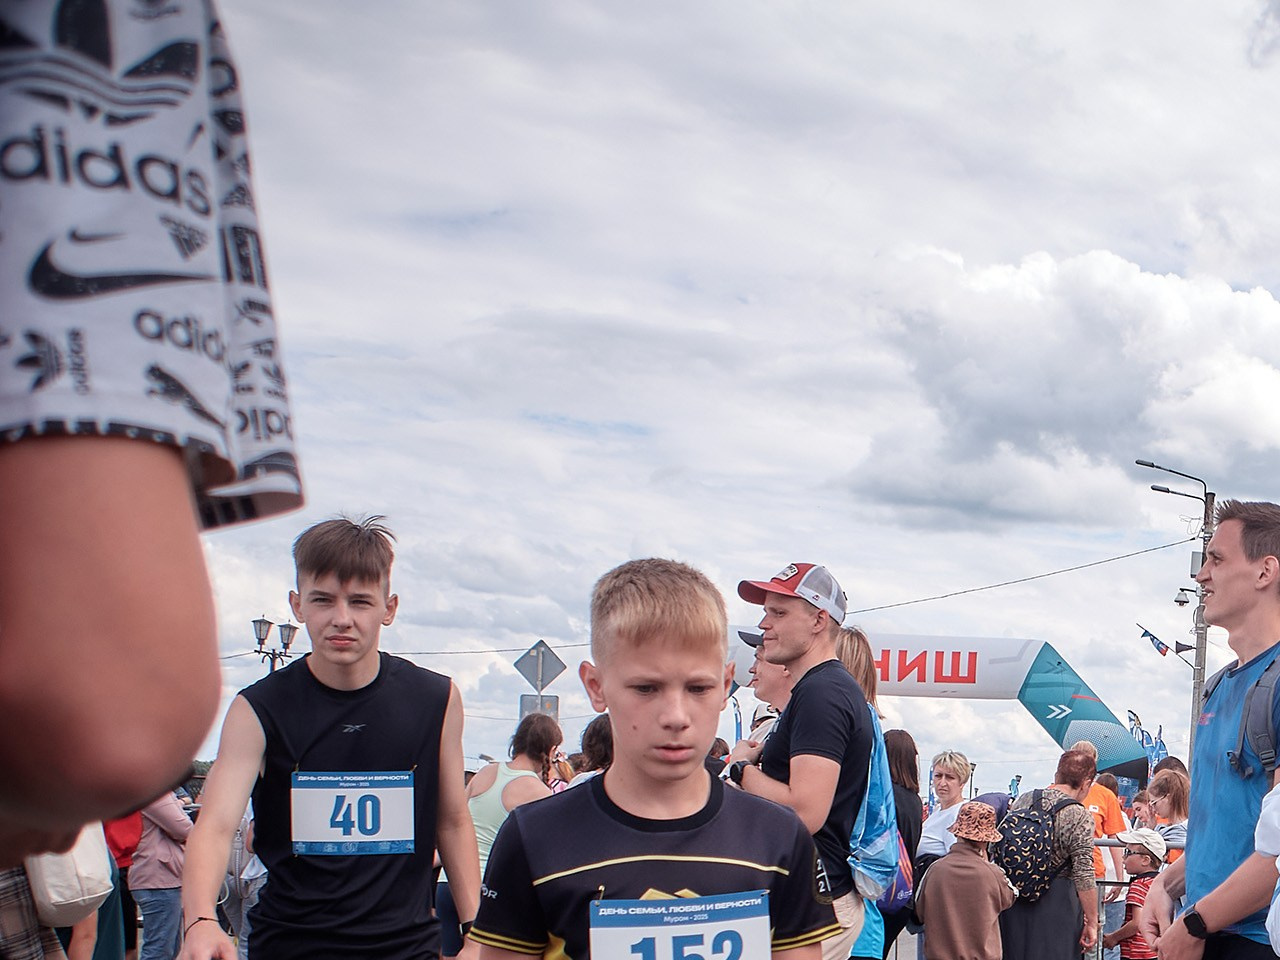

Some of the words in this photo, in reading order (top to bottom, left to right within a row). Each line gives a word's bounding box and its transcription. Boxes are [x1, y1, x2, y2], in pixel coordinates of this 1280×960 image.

[330, 794, 381, 837] 40
[598, 907, 628, 915] ДЕНЬ
[668, 904, 706, 913] ЛЮБВИ
[714, 898, 762, 910] ВЕРНОСТИ
[663, 916, 689, 924] Муром
